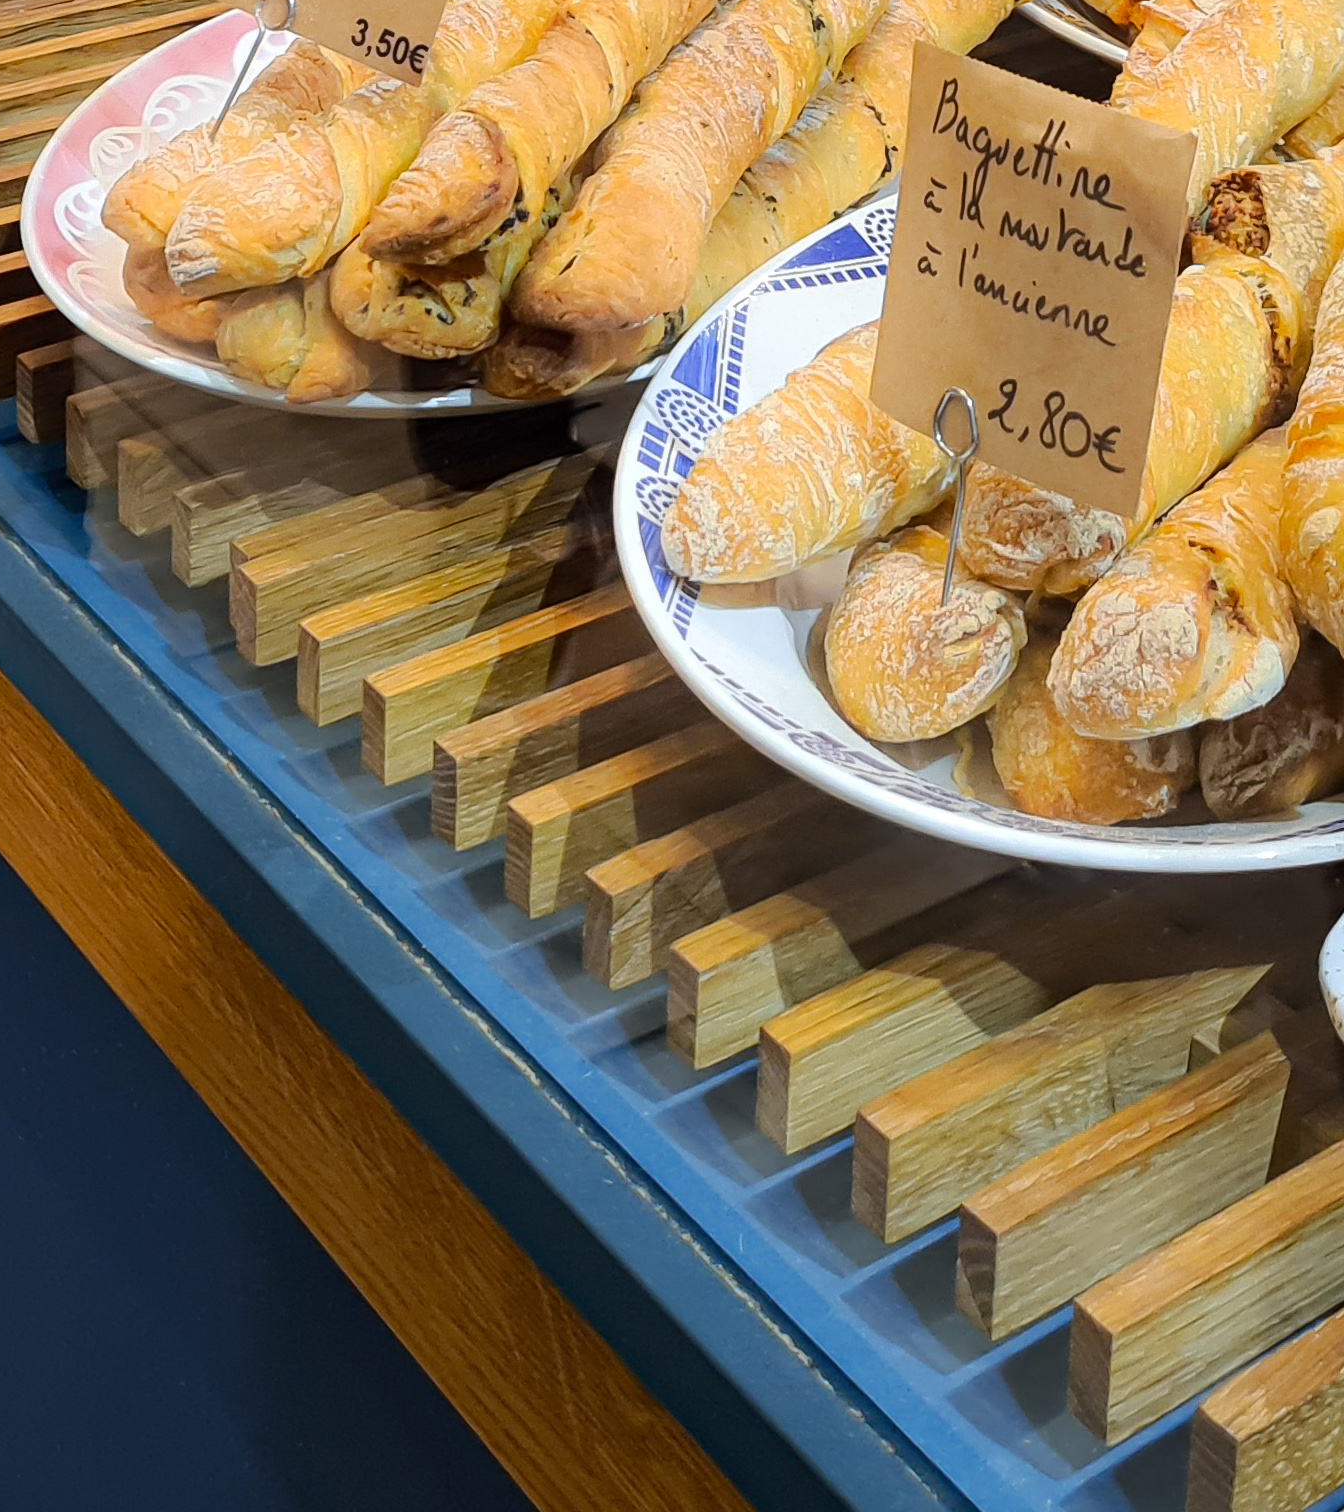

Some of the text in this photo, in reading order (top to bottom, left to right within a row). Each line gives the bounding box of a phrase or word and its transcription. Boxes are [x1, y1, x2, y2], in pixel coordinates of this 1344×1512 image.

[351, 18, 430, 74] 3,50€
[932, 78, 1126, 211] Baguettine
[924, 172, 1147, 278] à la moutarde
[917, 241, 1116, 347] à l'ancienne
[988, 378, 1126, 474] 2,80€
